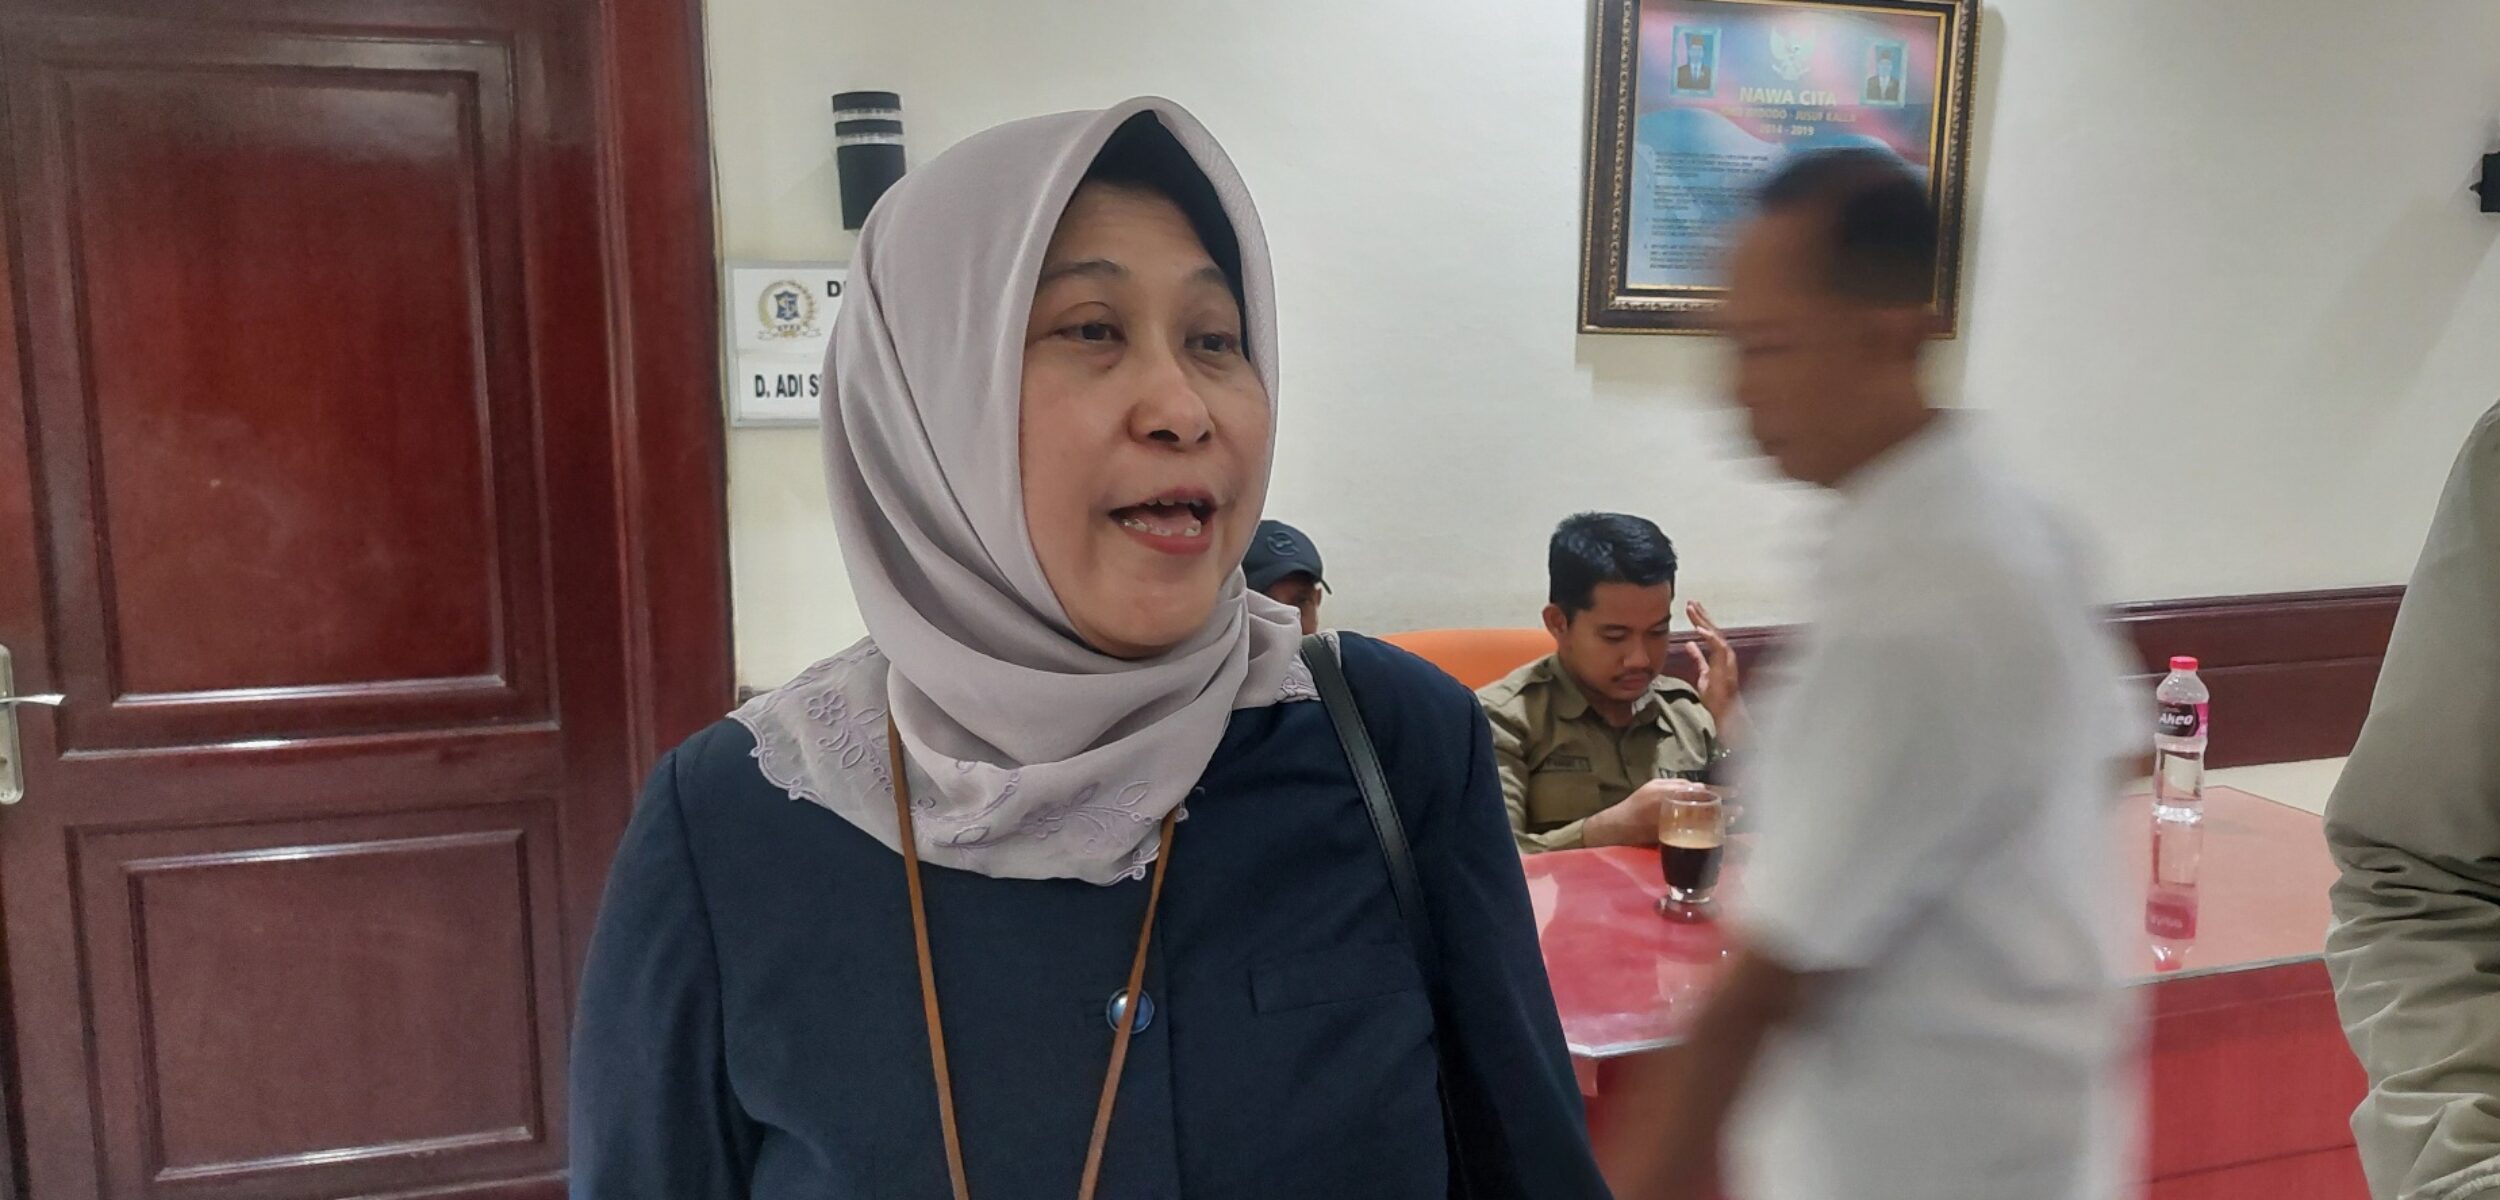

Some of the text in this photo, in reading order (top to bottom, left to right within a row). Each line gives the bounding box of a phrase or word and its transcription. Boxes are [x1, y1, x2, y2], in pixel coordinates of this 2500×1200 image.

[1740, 87, 1837, 106] NAWA CITA
[1791, 125, 1815, 136] 2019
[827, 281, 846, 297] D
[755, 374, 822, 398] D. ADI S
